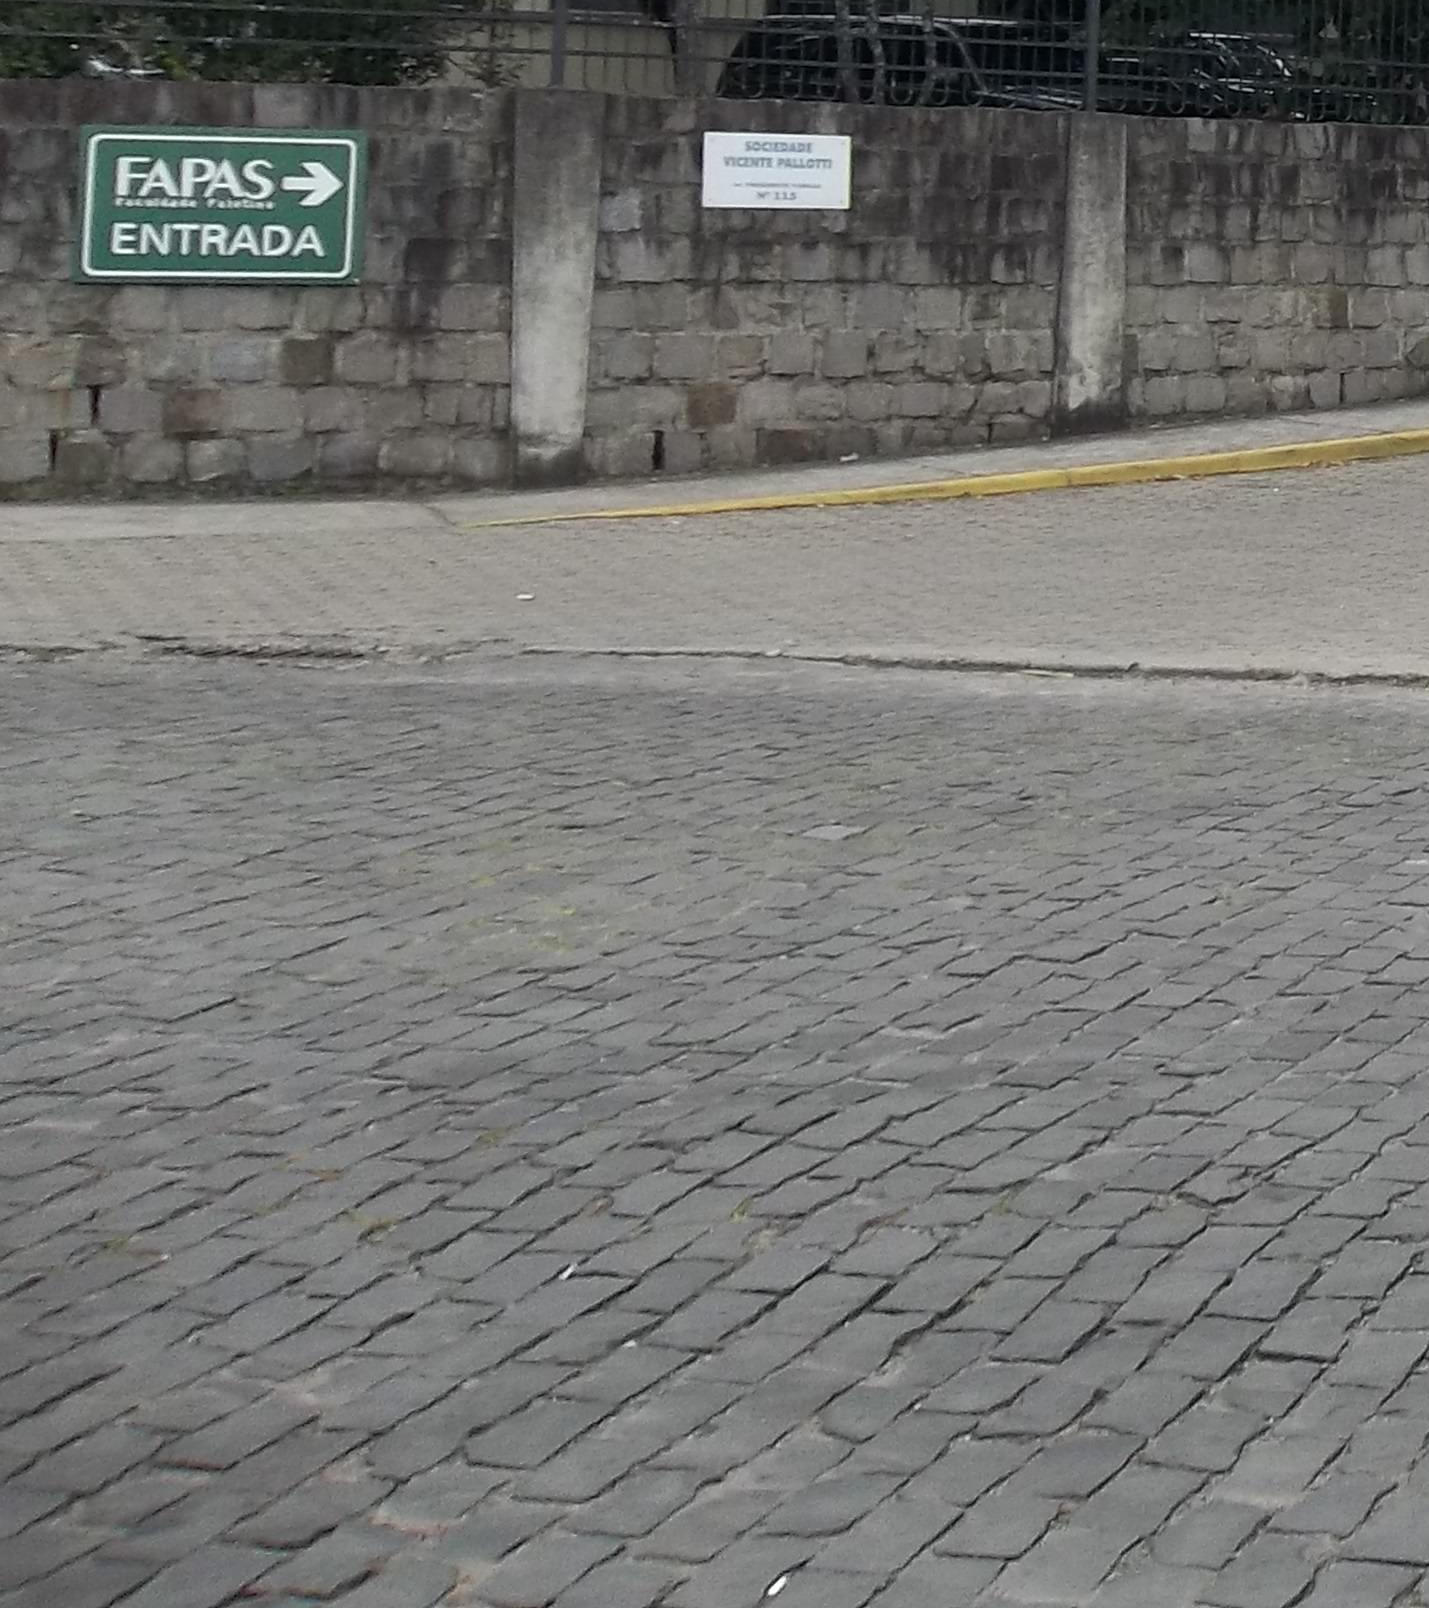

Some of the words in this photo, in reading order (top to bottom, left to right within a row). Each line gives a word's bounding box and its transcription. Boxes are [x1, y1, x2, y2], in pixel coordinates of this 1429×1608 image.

[745, 141, 813, 153] SOCIEDADE
[723, 156, 773, 168] VICENTE
[777, 158, 832, 169] PALLOTTI
[116, 156, 275, 200] FAPAS
[111, 222, 325, 257] ENTRADA
